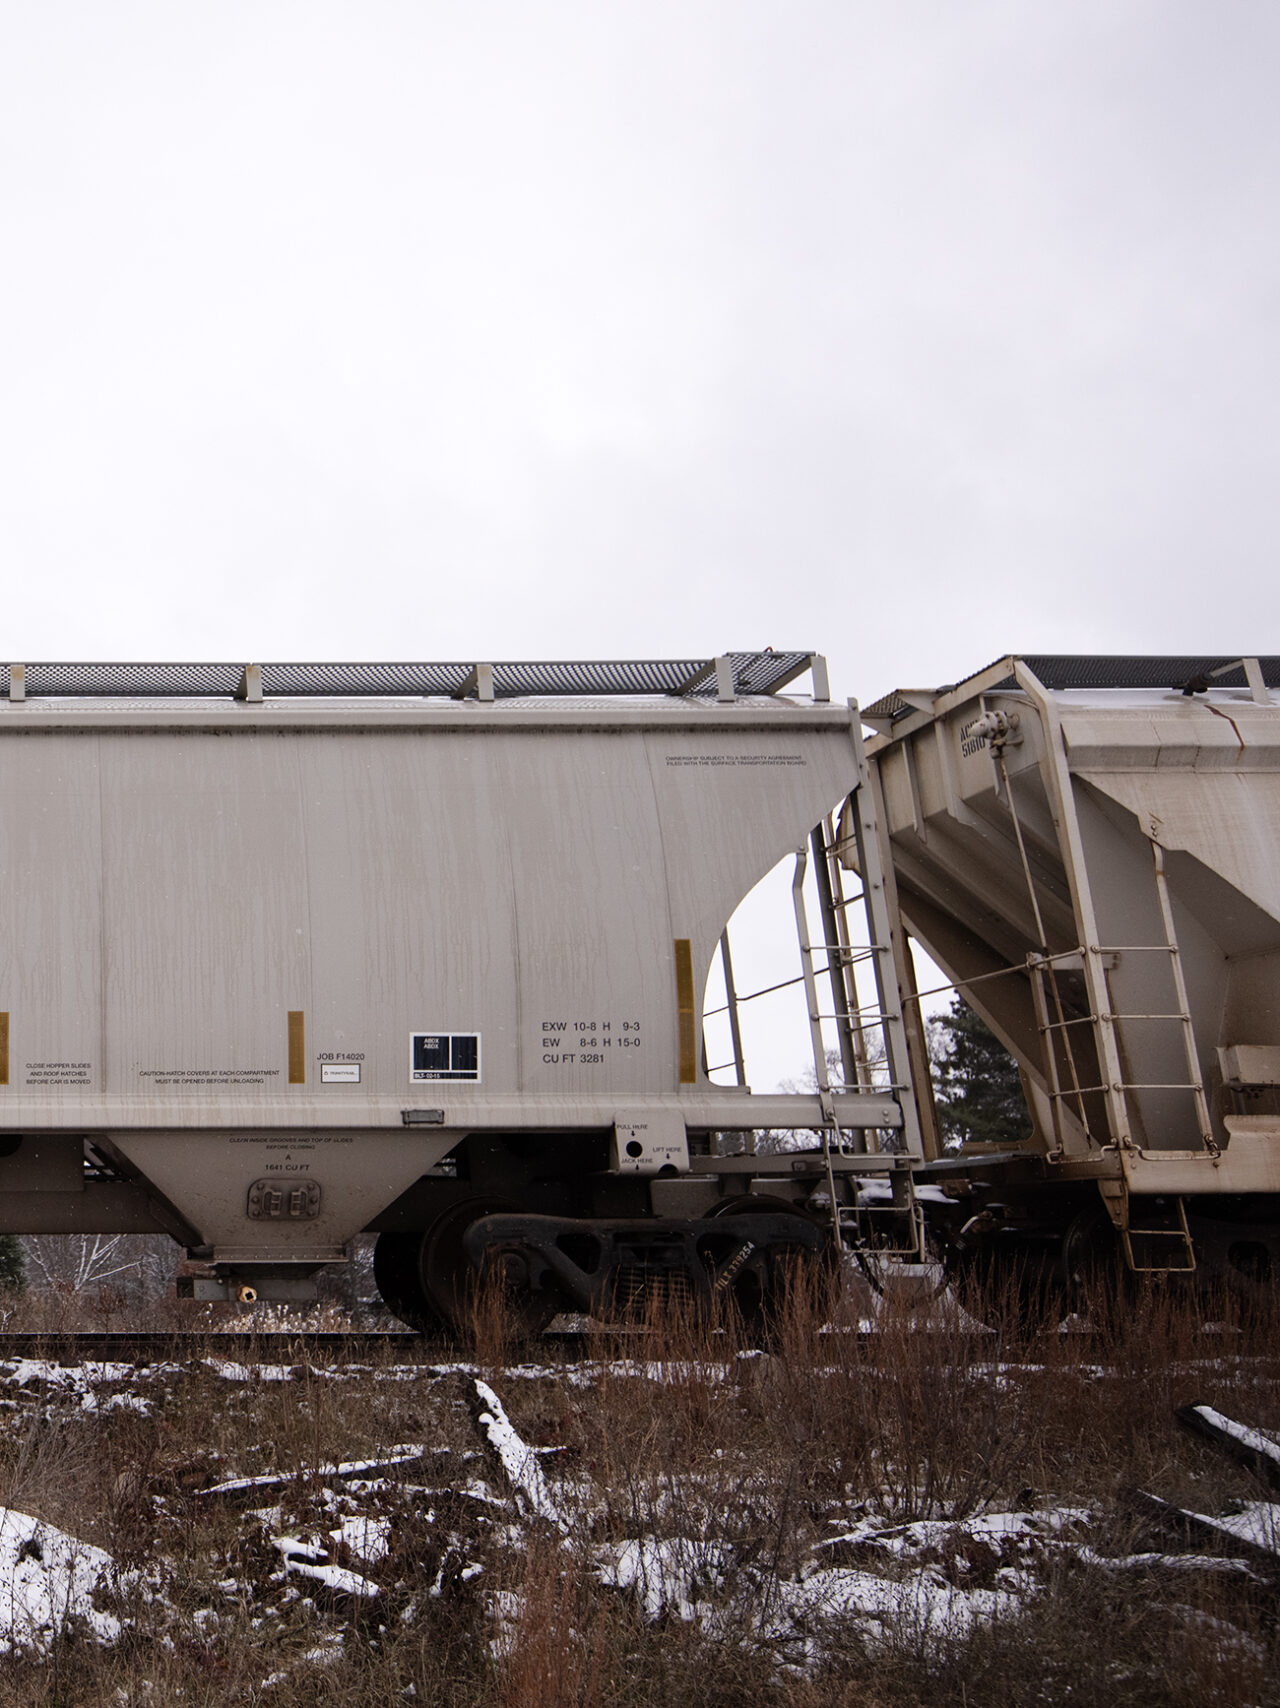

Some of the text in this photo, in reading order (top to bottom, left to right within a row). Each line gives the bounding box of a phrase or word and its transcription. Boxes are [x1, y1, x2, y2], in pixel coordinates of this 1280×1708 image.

[542, 1022, 640, 1031] EXW 10-8 H 9-3
[542, 1038, 641, 1047] EW 8-6 H 15-0
[542, 1054, 604, 1063] CU FT 3281
